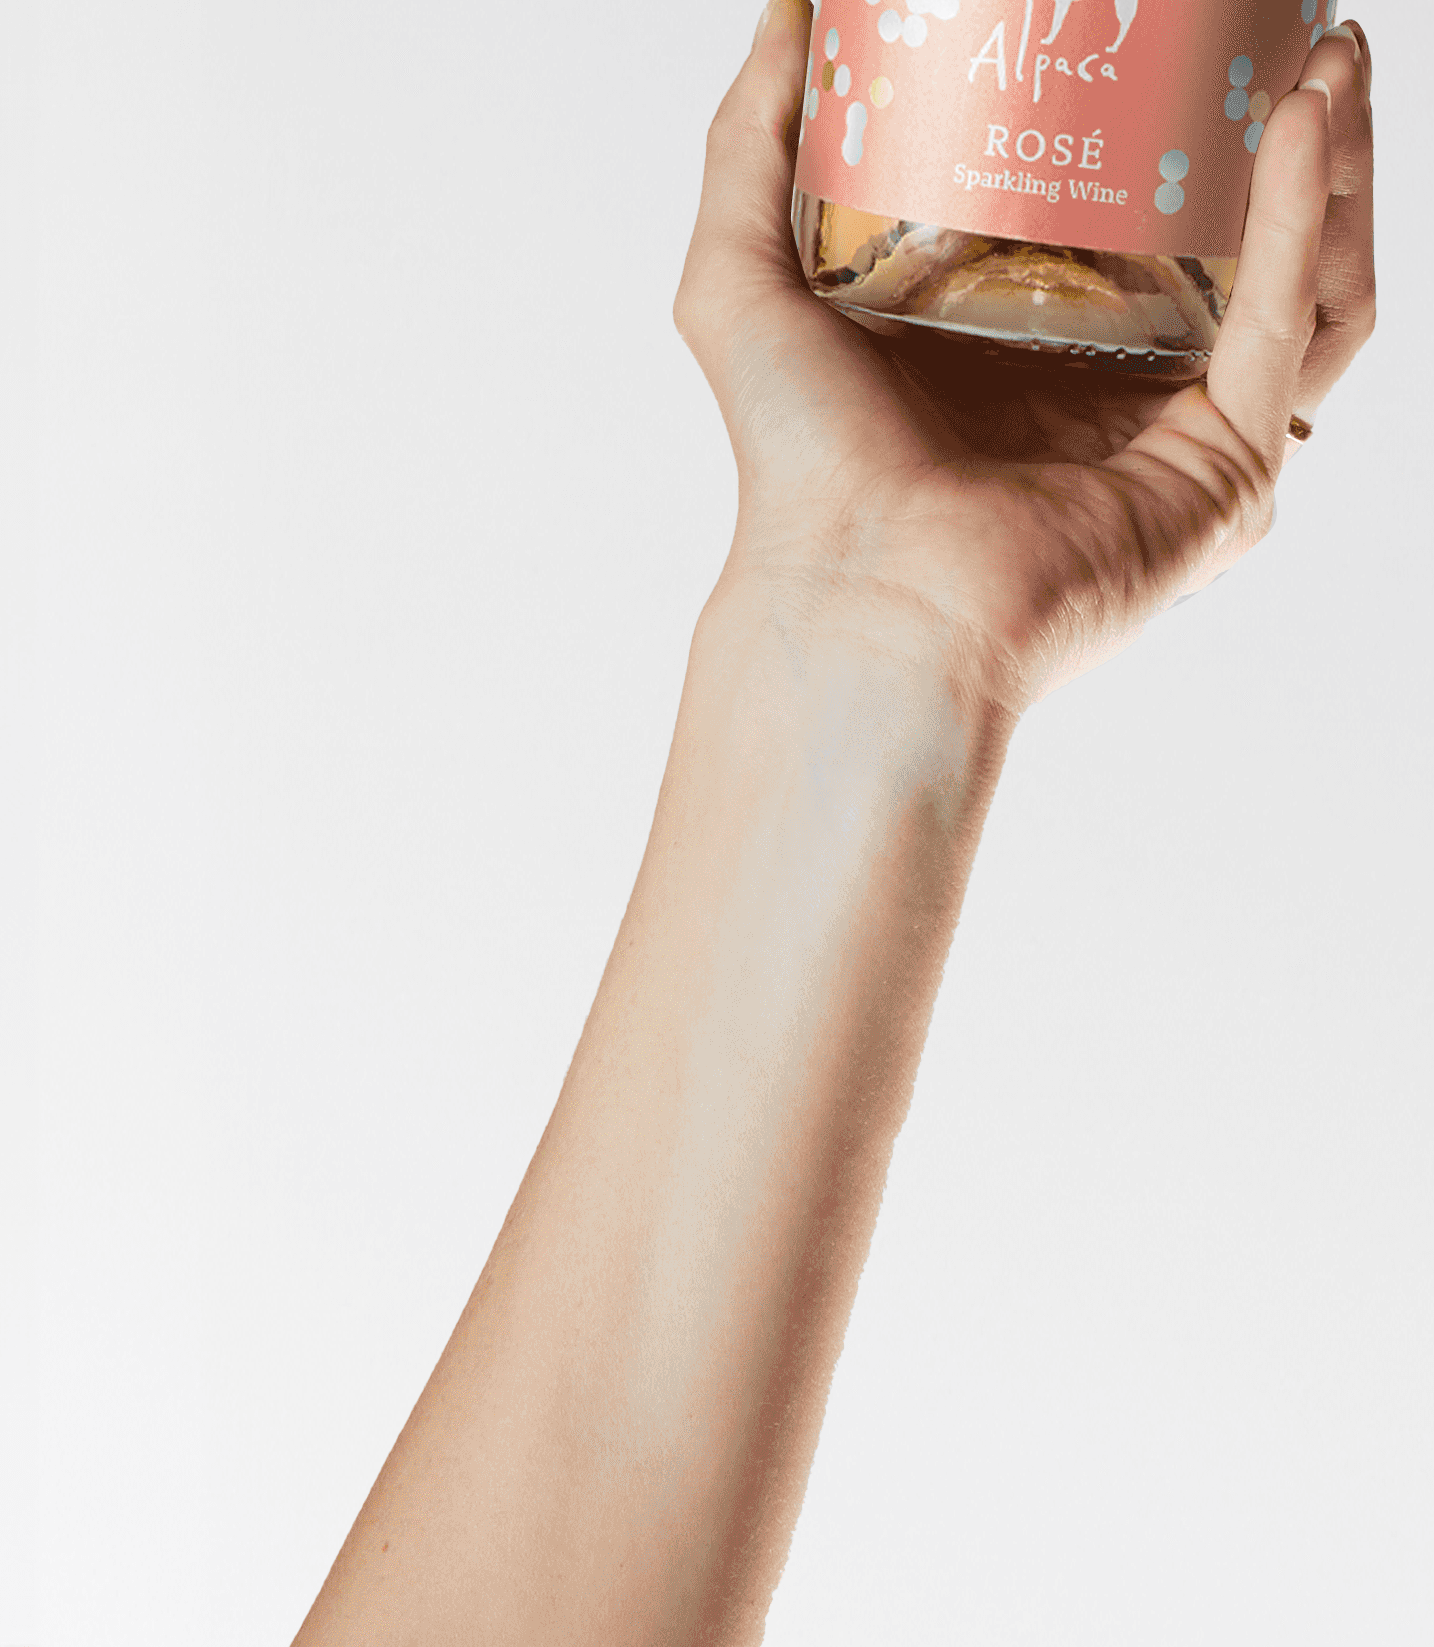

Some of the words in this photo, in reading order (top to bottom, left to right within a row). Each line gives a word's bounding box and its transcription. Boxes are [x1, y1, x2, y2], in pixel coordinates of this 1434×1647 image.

[984, 123, 1105, 170] ROSÉ
[953, 162, 1062, 204] Sparkling
[1068, 178, 1129, 206] Wine
